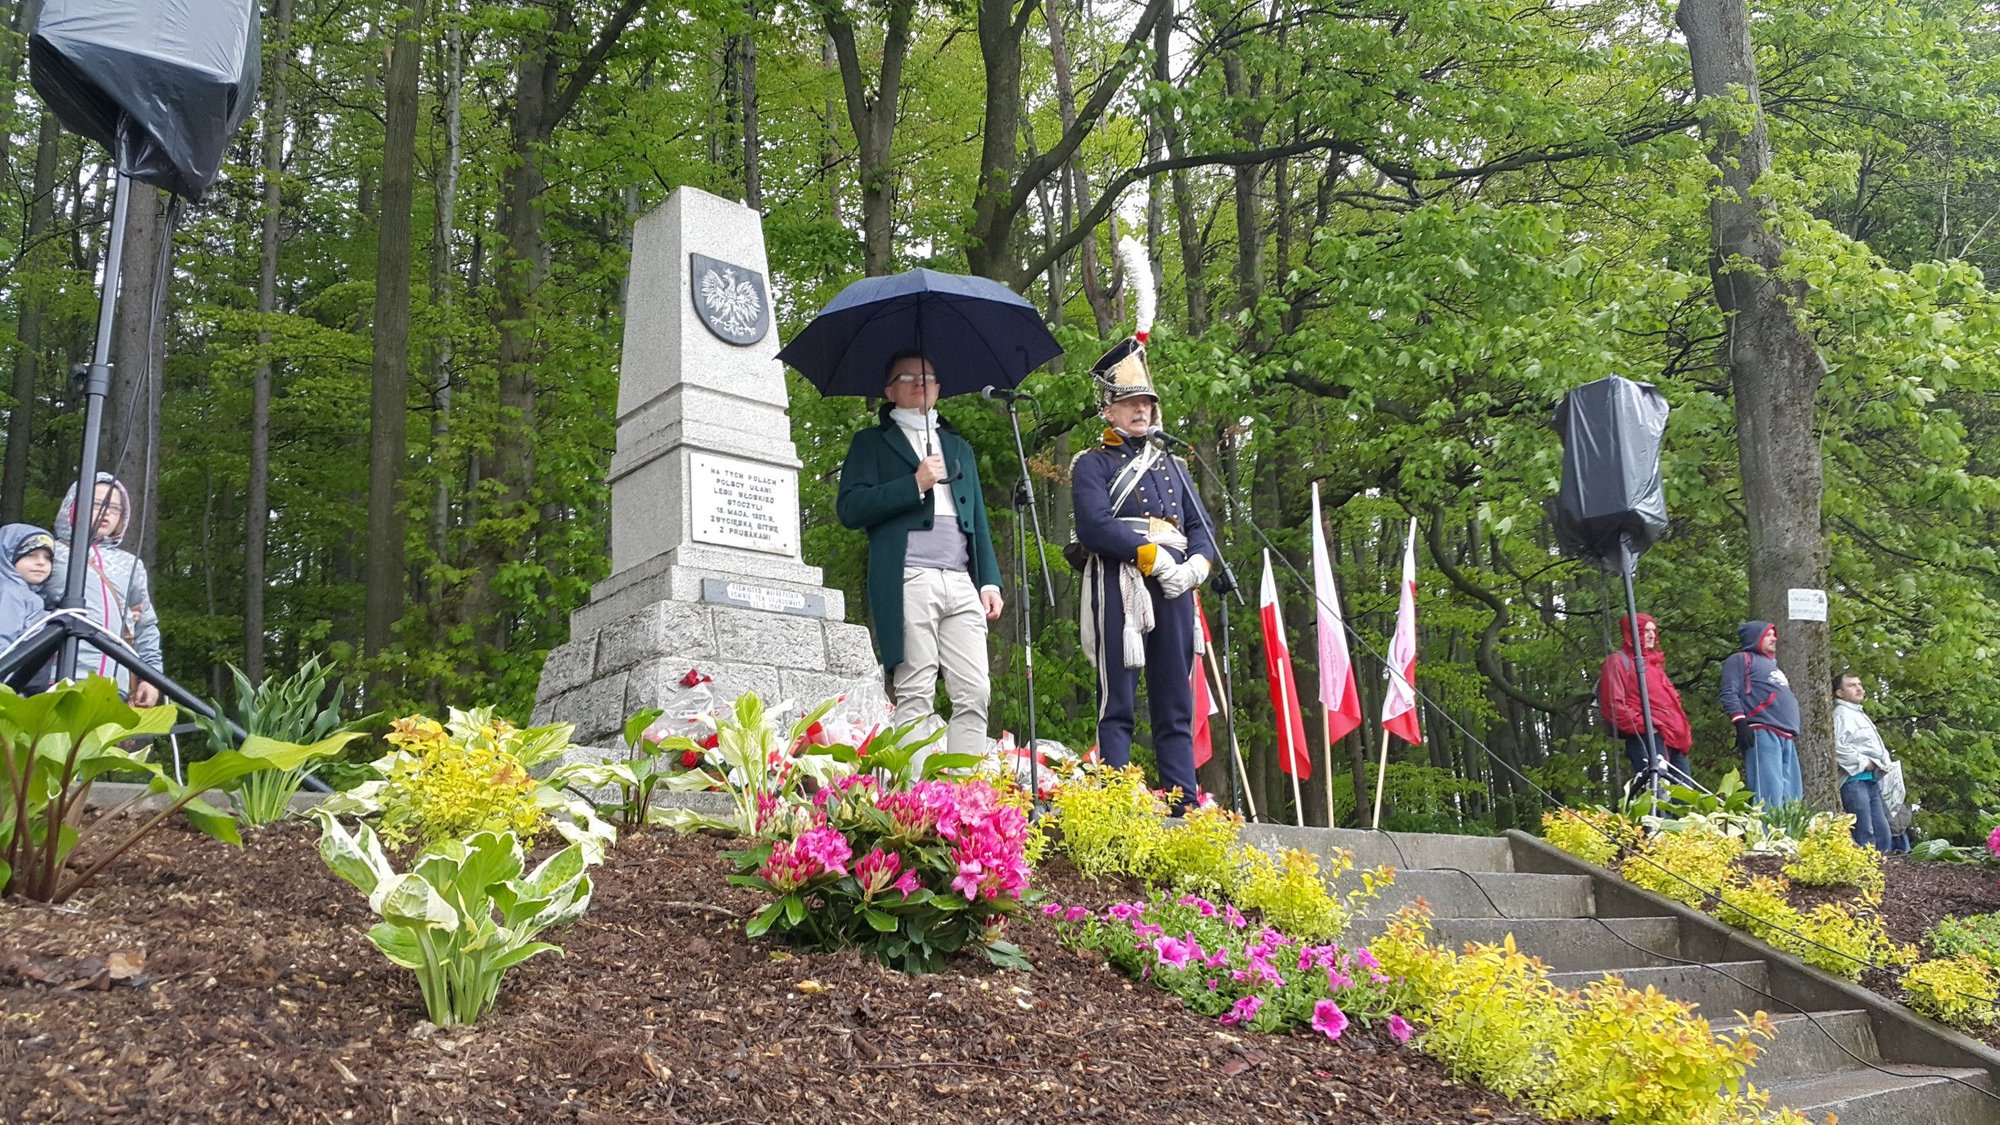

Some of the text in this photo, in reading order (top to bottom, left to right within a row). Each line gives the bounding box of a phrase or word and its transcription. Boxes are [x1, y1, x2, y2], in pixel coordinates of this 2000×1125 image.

[725, 470, 744, 479] TYCH
[748, 474, 777, 486] POLACH
[716, 478, 772, 494] POLSCY UŁANI
[727, 499, 763, 511] STOCZYLI
[729, 528, 771, 540] PRUSAKAMI
